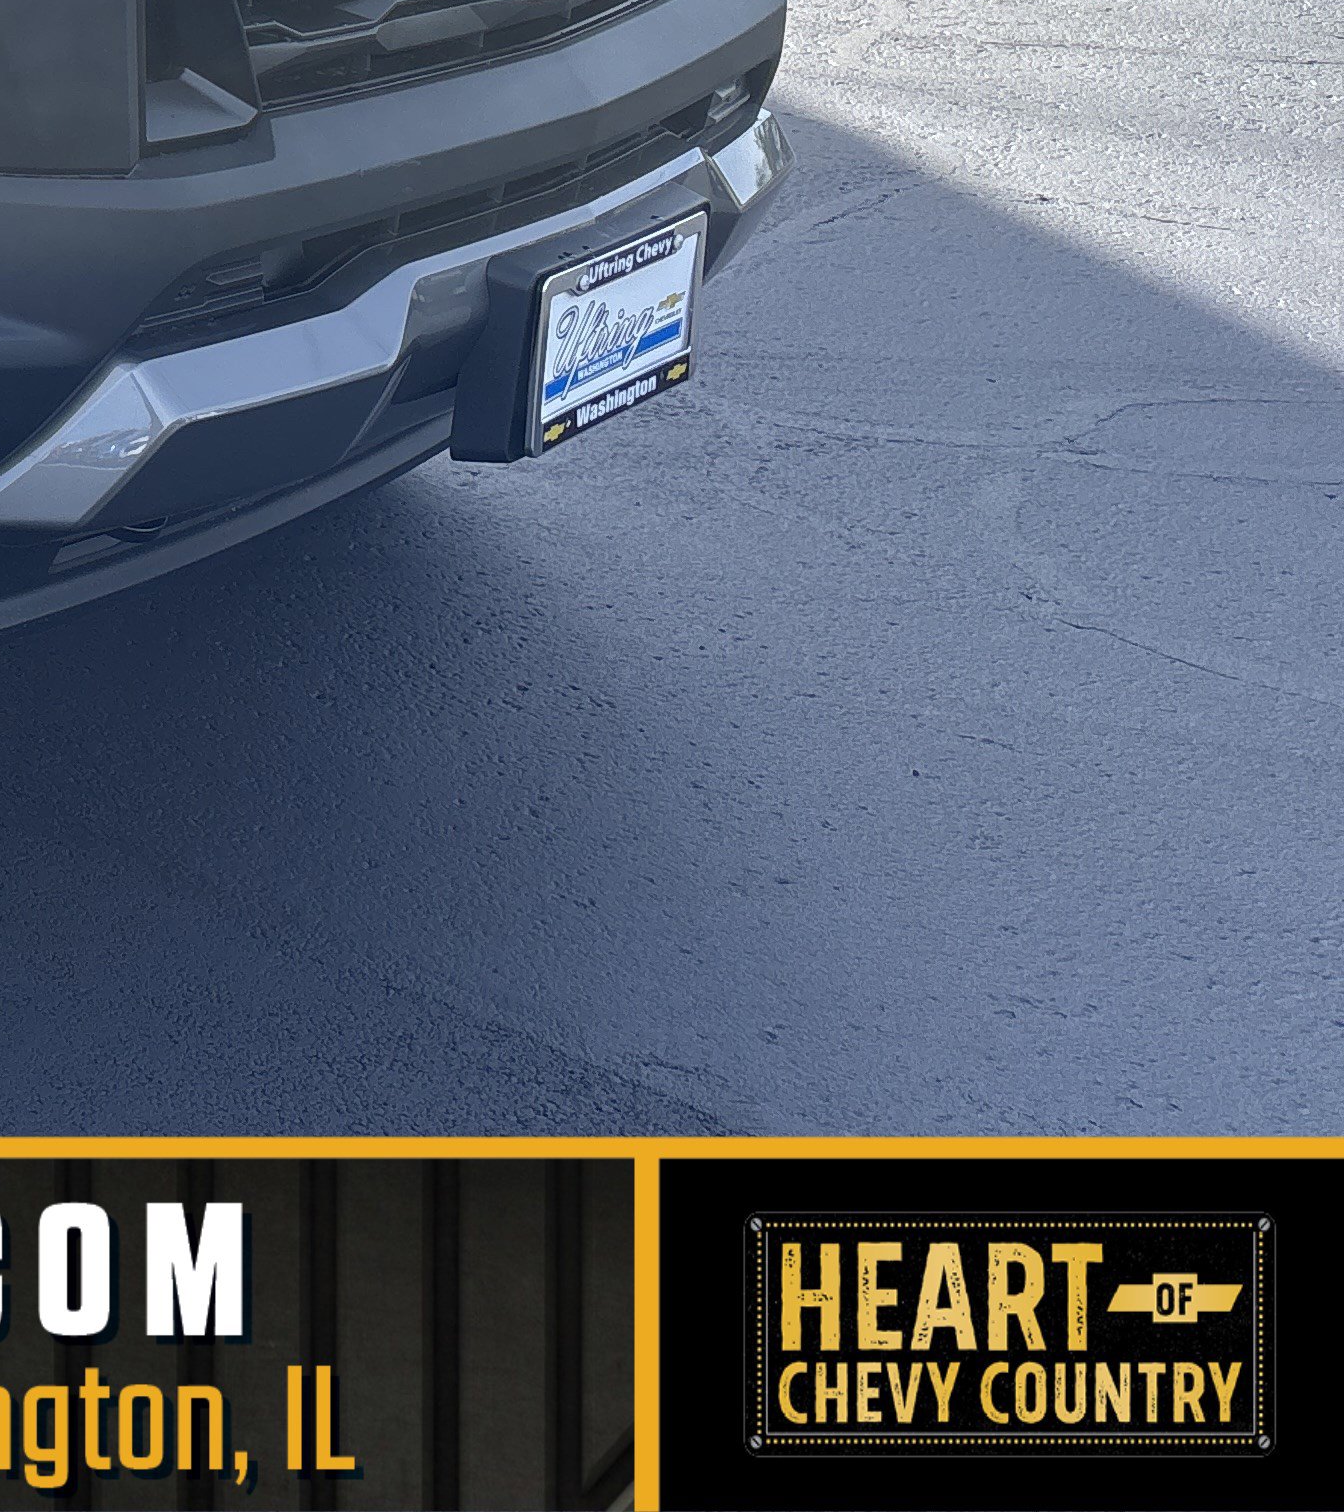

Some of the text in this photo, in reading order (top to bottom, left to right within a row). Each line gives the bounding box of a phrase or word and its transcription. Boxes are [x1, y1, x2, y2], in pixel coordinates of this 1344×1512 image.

[588, 235, 673, 286] Uftring Chevy
[575, 375, 657, 427] Washington
